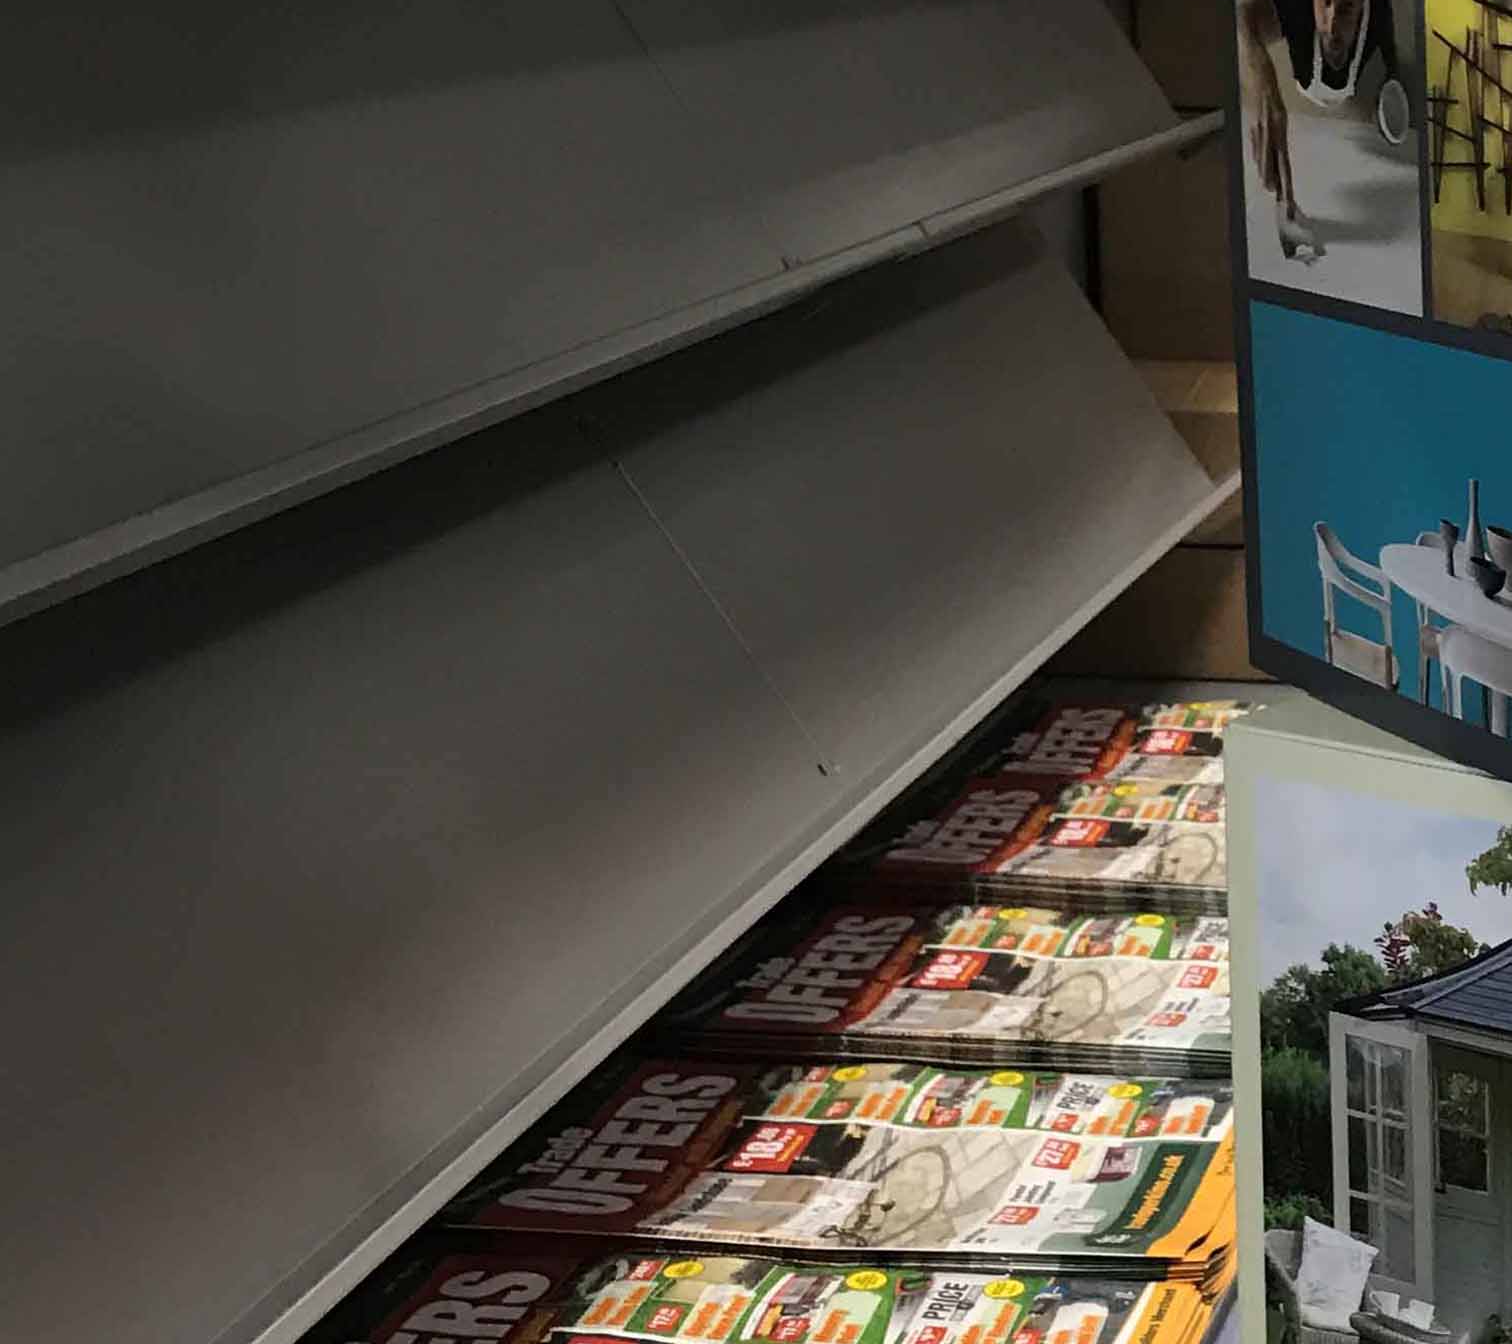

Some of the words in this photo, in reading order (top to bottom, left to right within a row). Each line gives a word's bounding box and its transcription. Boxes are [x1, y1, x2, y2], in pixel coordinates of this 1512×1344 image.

[723, 915, 915, 1024] OFFERS
[500, 1072, 737, 1216] OFFERS
[921, 1281, 969, 1321] PRICE
